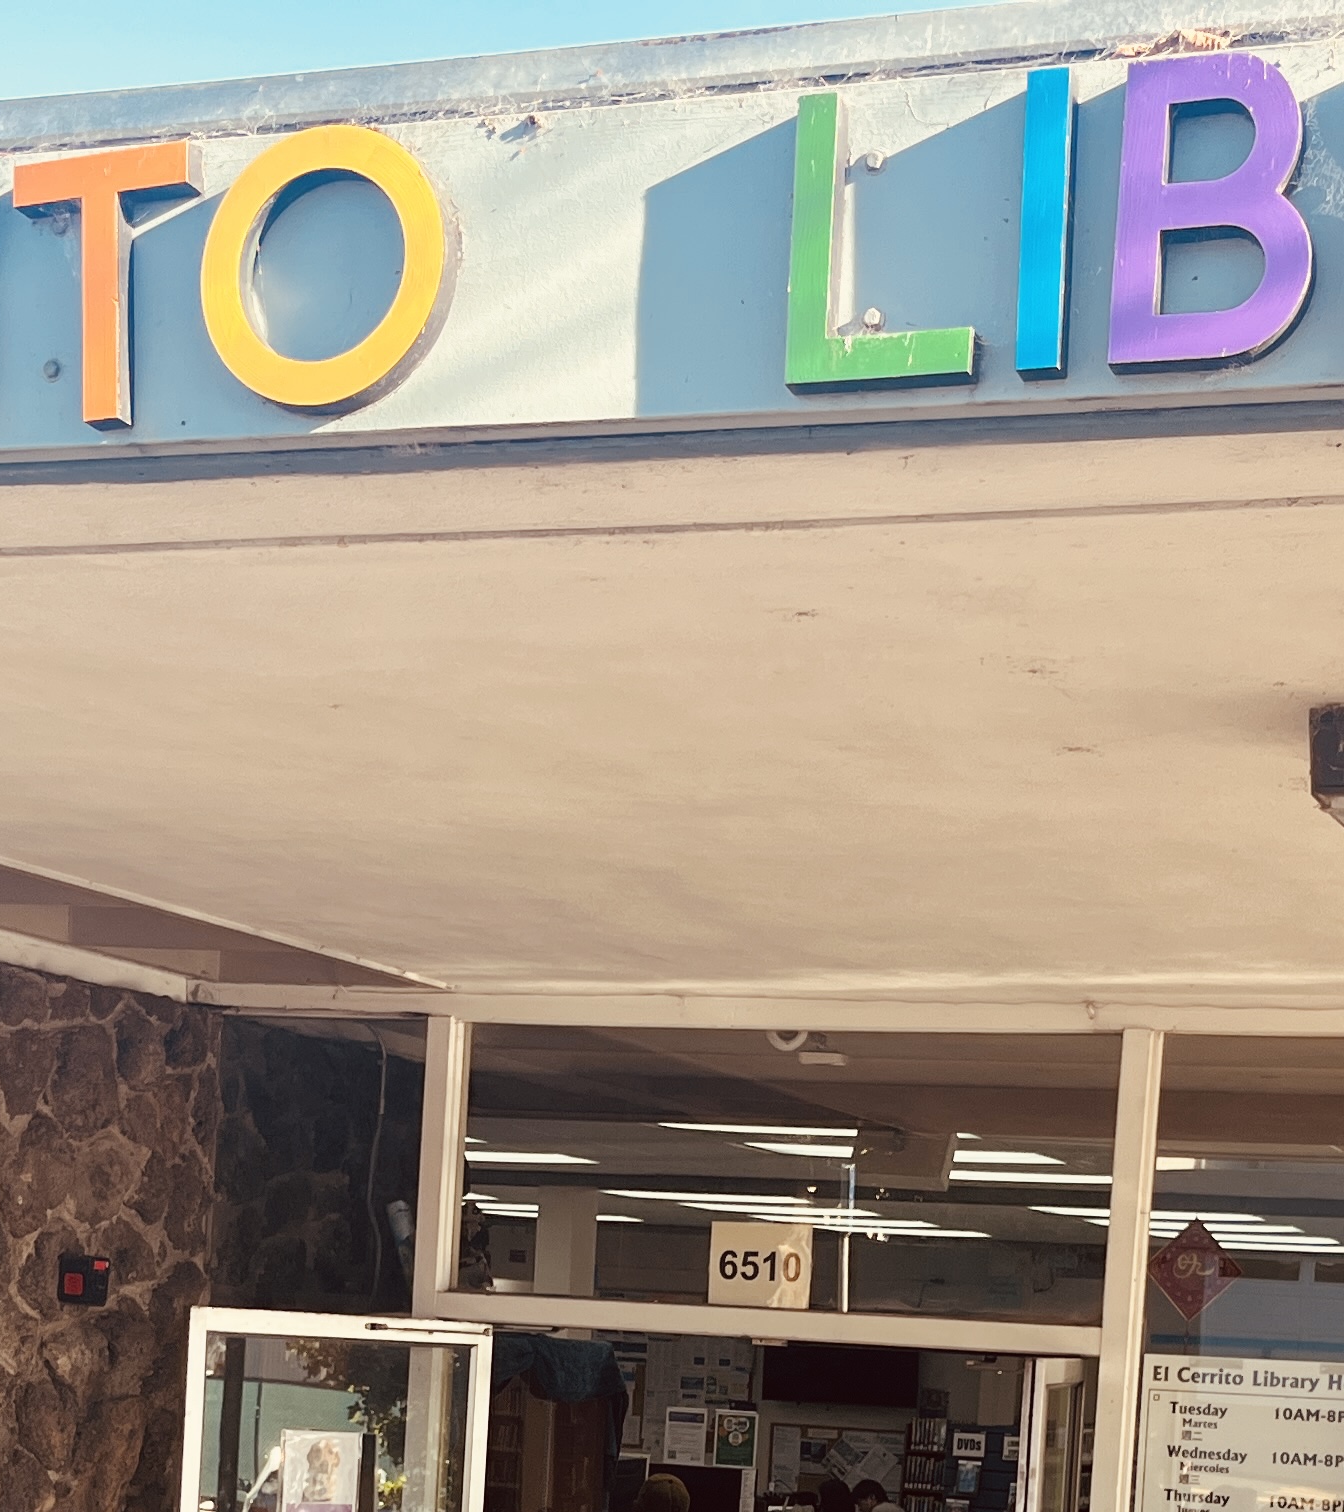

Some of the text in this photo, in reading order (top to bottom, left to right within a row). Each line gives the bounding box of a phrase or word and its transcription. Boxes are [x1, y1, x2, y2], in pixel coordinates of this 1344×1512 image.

[719, 1250, 801, 1282] 6510
[1153, 1366, 1169, 1381] El
[1177, 1367, 1244, 1386] Cerrito
[1252, 1370, 1320, 1392] Library
[1169, 1401, 1228, 1419] Tuesday
[1182, 1418, 1218, 1429] Martes
[957, 1438, 982, 1451] DVDs
[1167, 1445, 1248, 1464] Wednesday
[1164, 1488, 1230, 1507] Thursday
